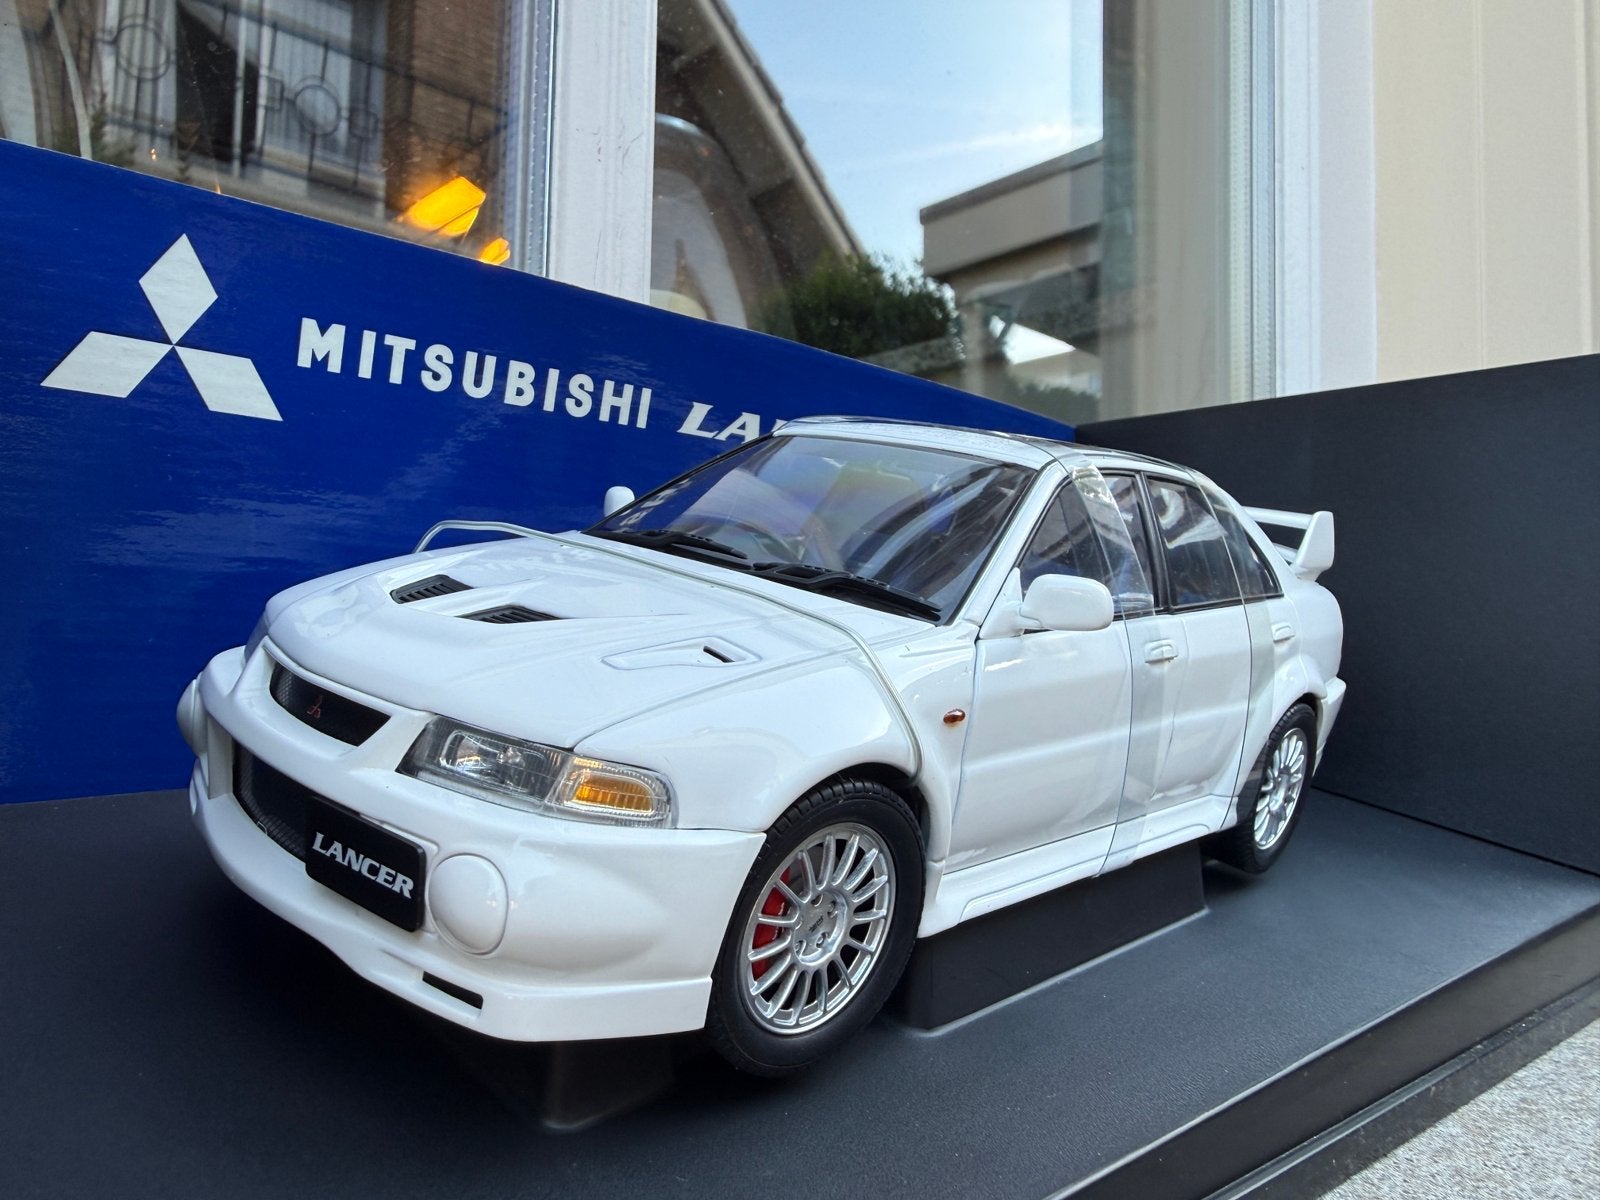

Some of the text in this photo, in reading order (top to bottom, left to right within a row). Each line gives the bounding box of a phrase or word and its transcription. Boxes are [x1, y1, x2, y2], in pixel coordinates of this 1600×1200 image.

[297, 317, 788, 444] MITSUBISHI LA
[312, 831, 414, 899] LANCER
